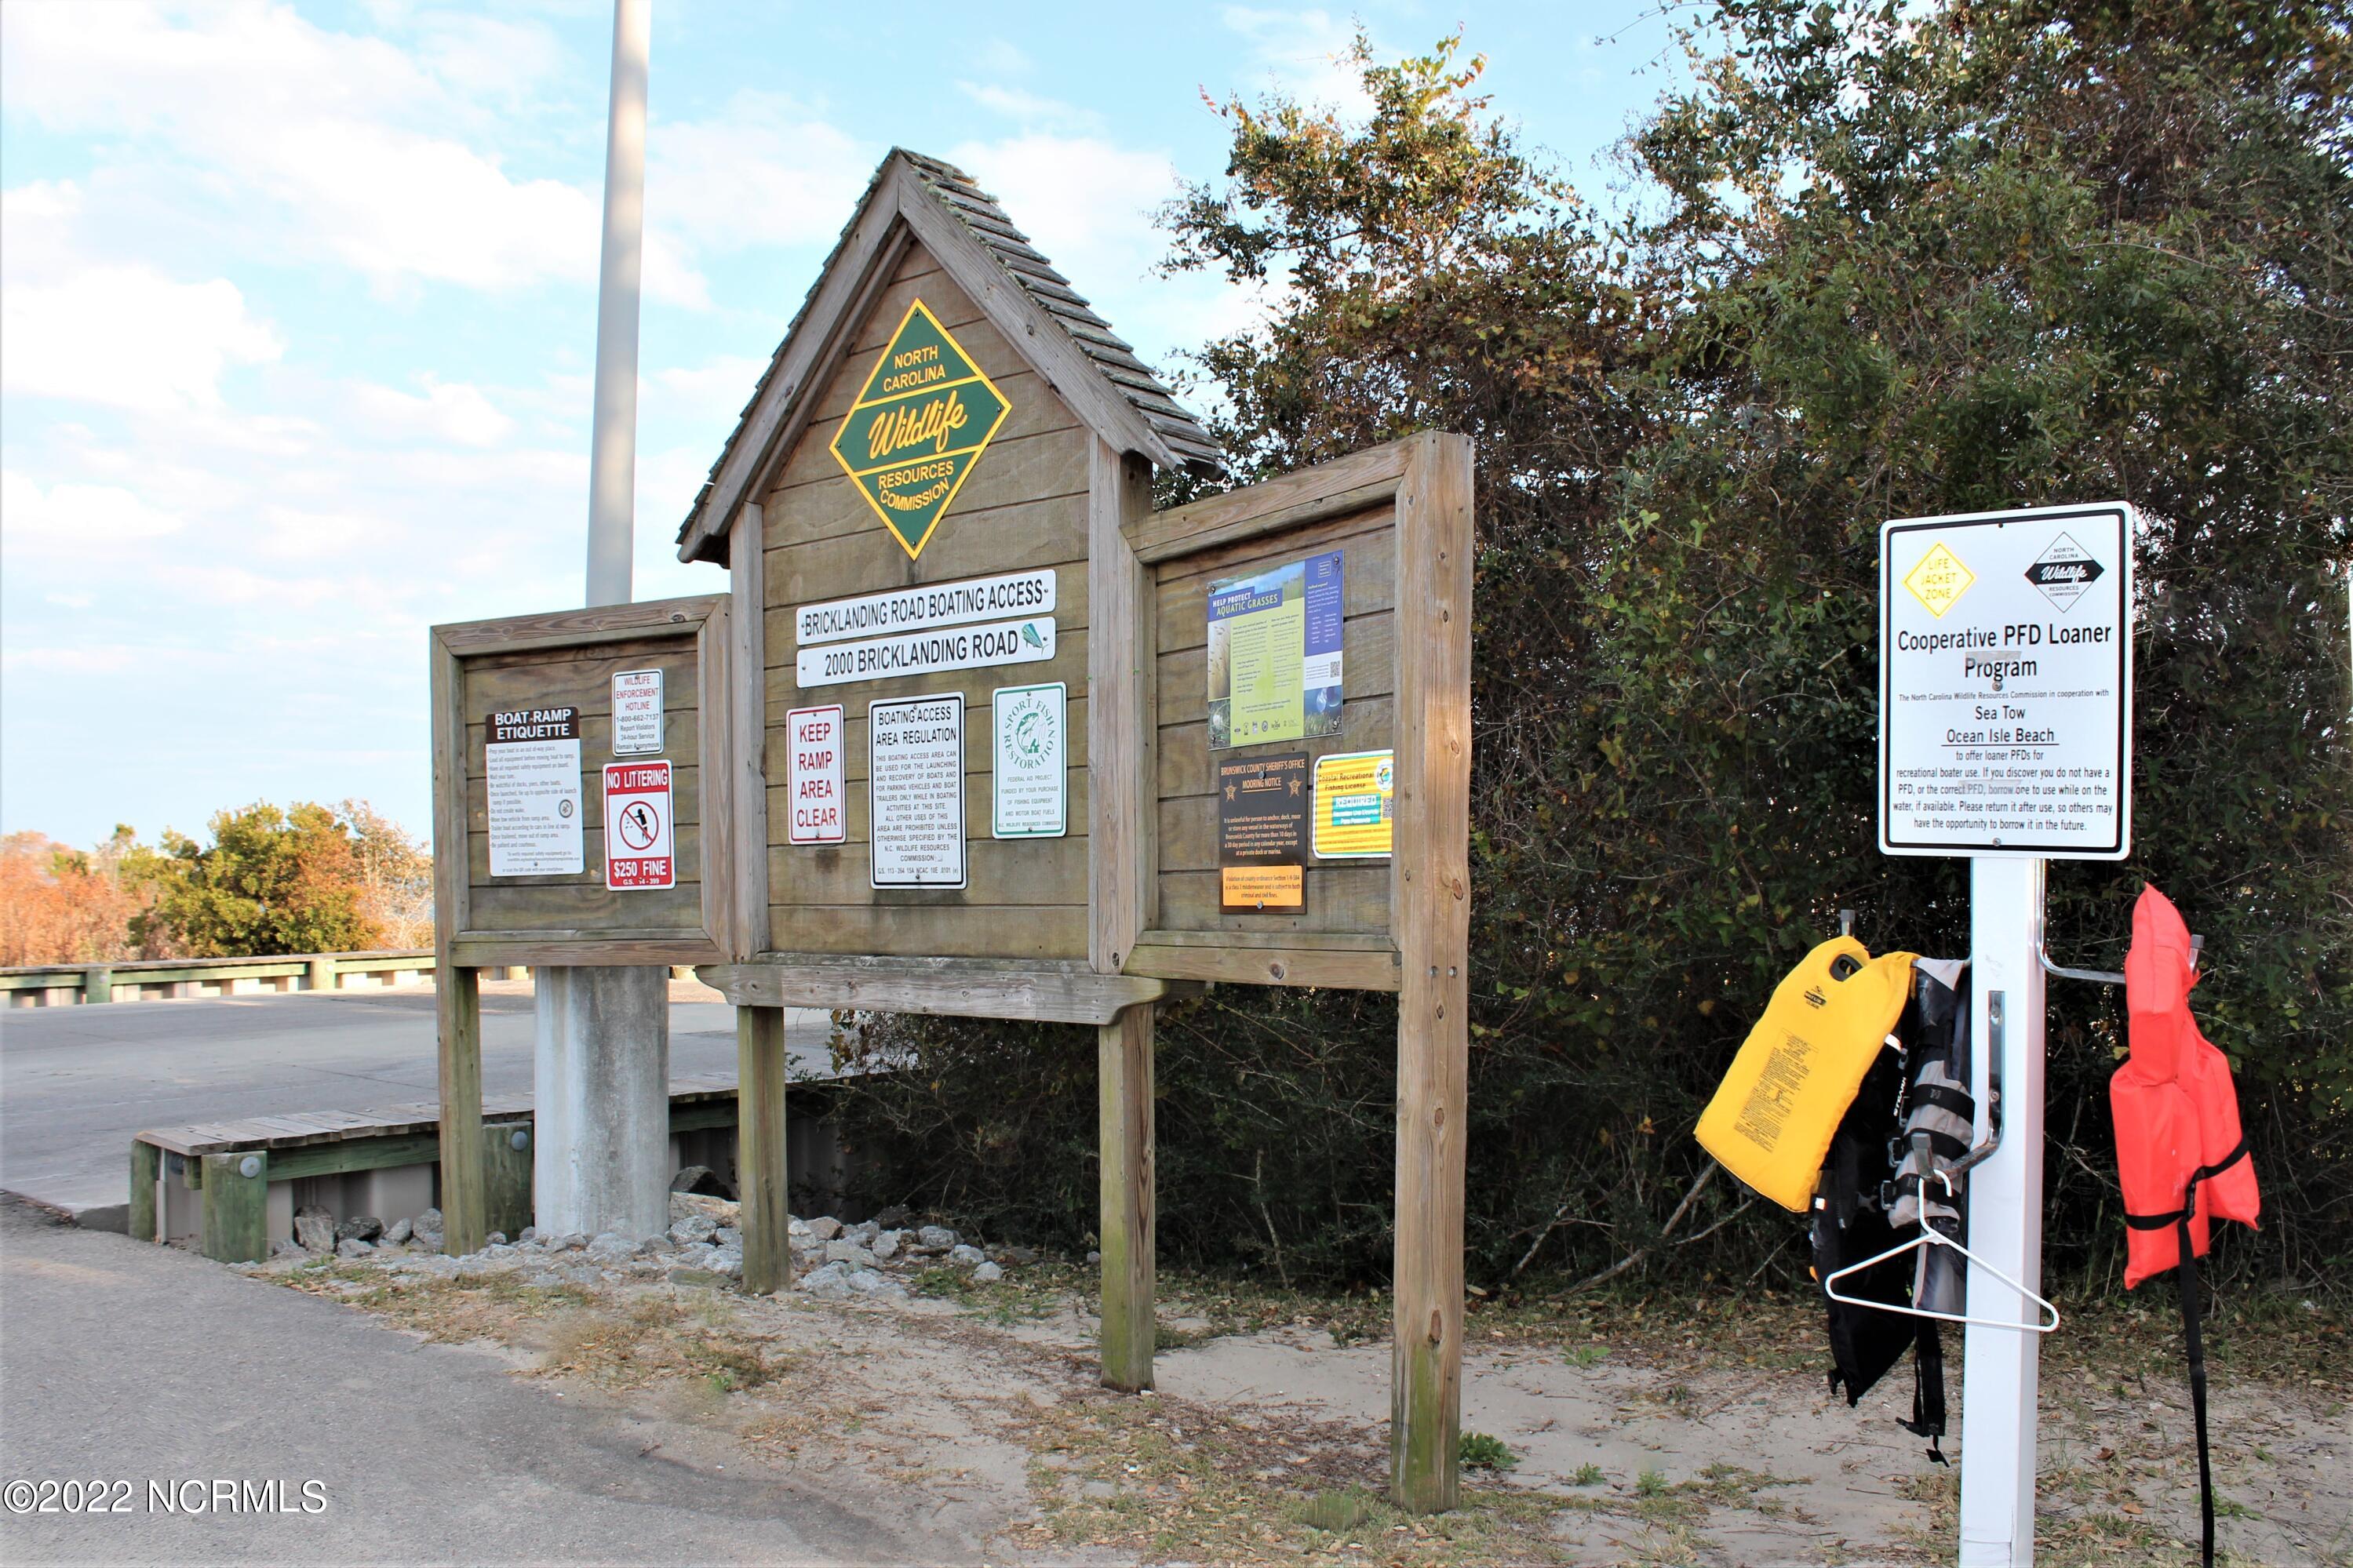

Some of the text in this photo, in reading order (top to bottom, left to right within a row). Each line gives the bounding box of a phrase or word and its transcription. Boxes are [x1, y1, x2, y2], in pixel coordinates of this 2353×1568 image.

[894, 345, 938, 369] NORTH
[883, 364, 945, 392] CAROLINA
[868, 390, 967, 460] Wildlife
[878, 460, 954, 489] RESOURCES
[880, 477, 949, 511] COMMISSION
[1929, 558, 1949, 569] LIFE
[1921, 573, 1957, 585] JACKET
[2041, 565, 2088, 583] Wildlife
[1212, 591, 1251, 607] HELP PROTECT
[1925, 588, 1951, 600] ZONE
[805, 579, 1043, 637] BRICKLANDING ROAD BOATING ACCESS
[1217, 593, 1278, 617] AQUATIC GRASSES
[1898, 624, 2111, 654] Cooperative PFD Loaner
[825, 630, 1018, 677] 2000 BRICKLANDING ROAD
[1965, 657, 2037, 682] Program
[624, 675, 650, 686] WILDLIFE
[616, 687, 659, 700] ENFORCEMENT
[2056, 689, 2093, 698] cooperation
[625, 700, 650, 711] HOTLINE
[1005, 698, 1054, 730] SPORT FISH
[1975, 705, 2026, 720] Sea Tow
[494, 708, 571, 726] BOAT RAMP
[879, 706, 952, 726] BOATING ACCESS
[497, 723, 570, 740] ETIQUETTE
[799, 722, 831, 743] KEEP
[876, 727, 956, 747] AREA REGULATION
[1947, 728, 2054, 743] Ocean Isle Beach
[1004, 729, 1055, 769] RESTORATION
[1956, 750, 2044, 760] to offer loaner PFDs for
[799, 751, 832, 771] RAMP
[1221, 759, 1305, 776] BRUNSWICK COUNTY SHERIFF'S OFFICE
[607, 769, 668, 789] NO LITTERING
[1318, 772, 1375, 783] Coastal Recreational
[1896, 767, 1937, 777] recreational
[1940, 768, 1962, 777] boater
[1965, 769, 1980, 777] use.
[1983, 766, 1989, 777] If
[1991, 769, 2004, 780] you
[2006, 767, 2038, 777] discover
[2040, 769, 2054, 780] you
[2056, 766, 2067, 777] do
[2068, 767, 2082, 777] not
[2084, 766, 2103, 777] have
[800, 780, 833, 799] AREA
[1242, 777, 1281, 789] MOORING NOTICE
[1898, 784, 1915, 795] PFD,
[1926, 784, 1938, 794] the
[1940, 785, 1965, 794] correct
[1968, 784, 1986, 795] PFD,
[1988, 784, 2013, 794] borrow
[2032, 785, 2040, 795] to
[2058, 784, 2079, 795] while
[2094, 784, 2107, 795] the
[1893, 801, 1914, 813] water,
[1915, 800, 1921, 810] if
[1923, 800, 1957, 811] available.
[1959, 801, 1983, 811] Please
[1985, 802, 2009, 812] return
[2011, 801, 2016, 812] it
[2018, 801, 2037, 812] after
[2038, 804, 2055, 814] use,
[2068, 802, 2093, 813] others
[2096, 805, 2113, 816] may
[796, 807, 837, 828] CLEAR
[1914, 817, 2087, 831] have the opportunity to borrow it in the future.
[614, 860, 667, 879] $250 FINE
